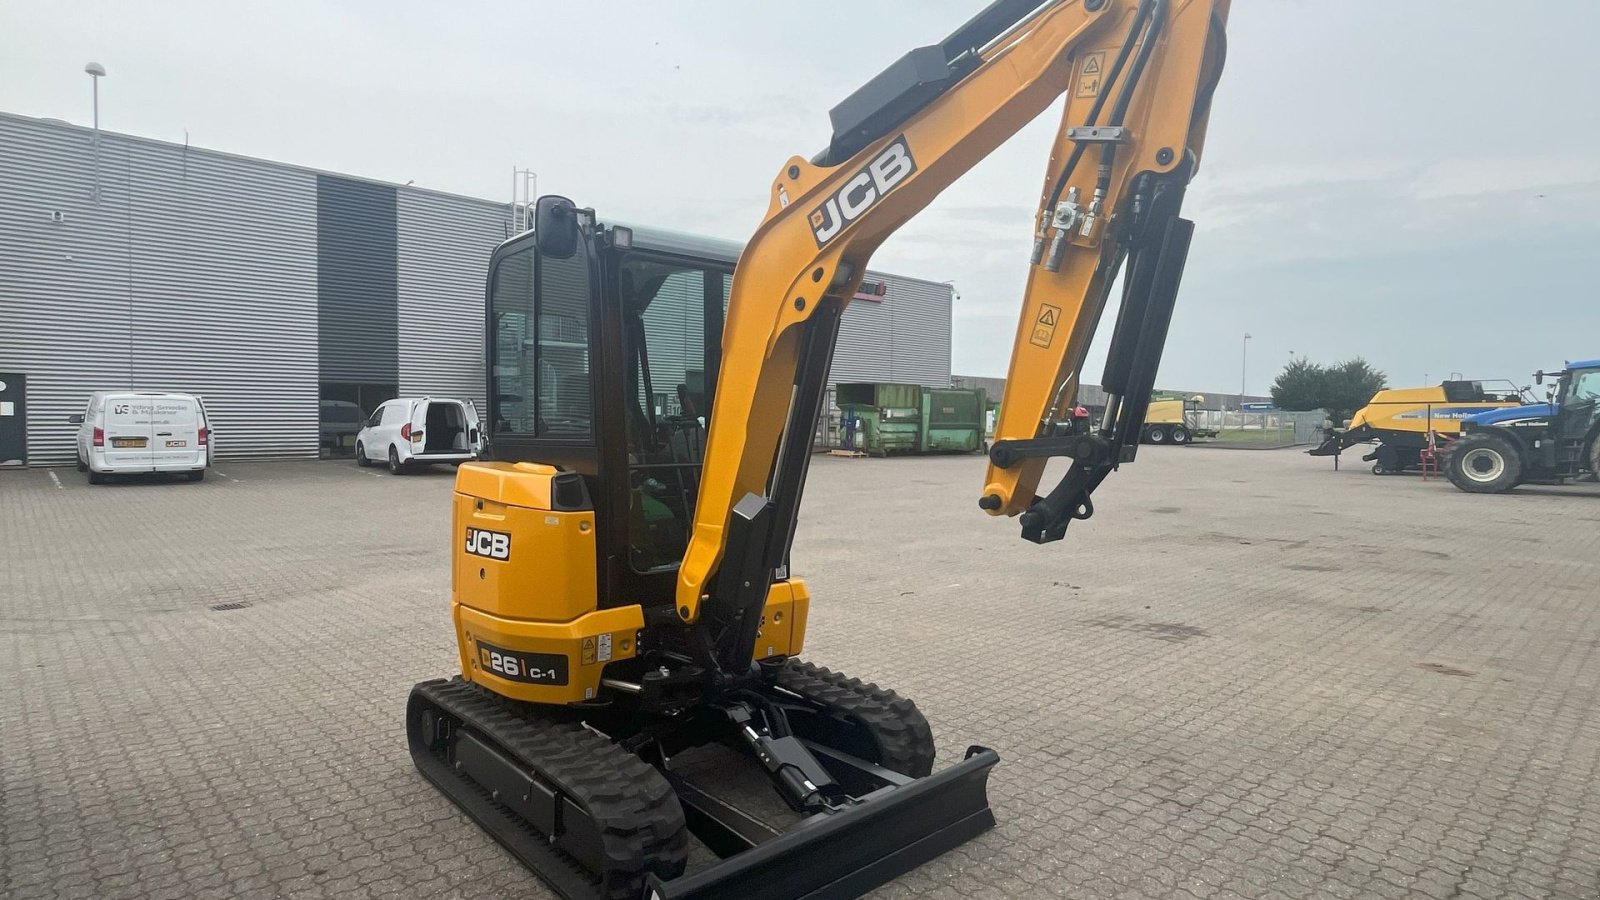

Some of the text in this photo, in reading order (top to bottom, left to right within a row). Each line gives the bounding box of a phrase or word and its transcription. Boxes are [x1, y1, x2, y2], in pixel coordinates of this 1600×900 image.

[815, 142, 912, 243] JCB
[466, 529, 509, 558] JCB
[490, 651, 556, 679] 26 C-1
